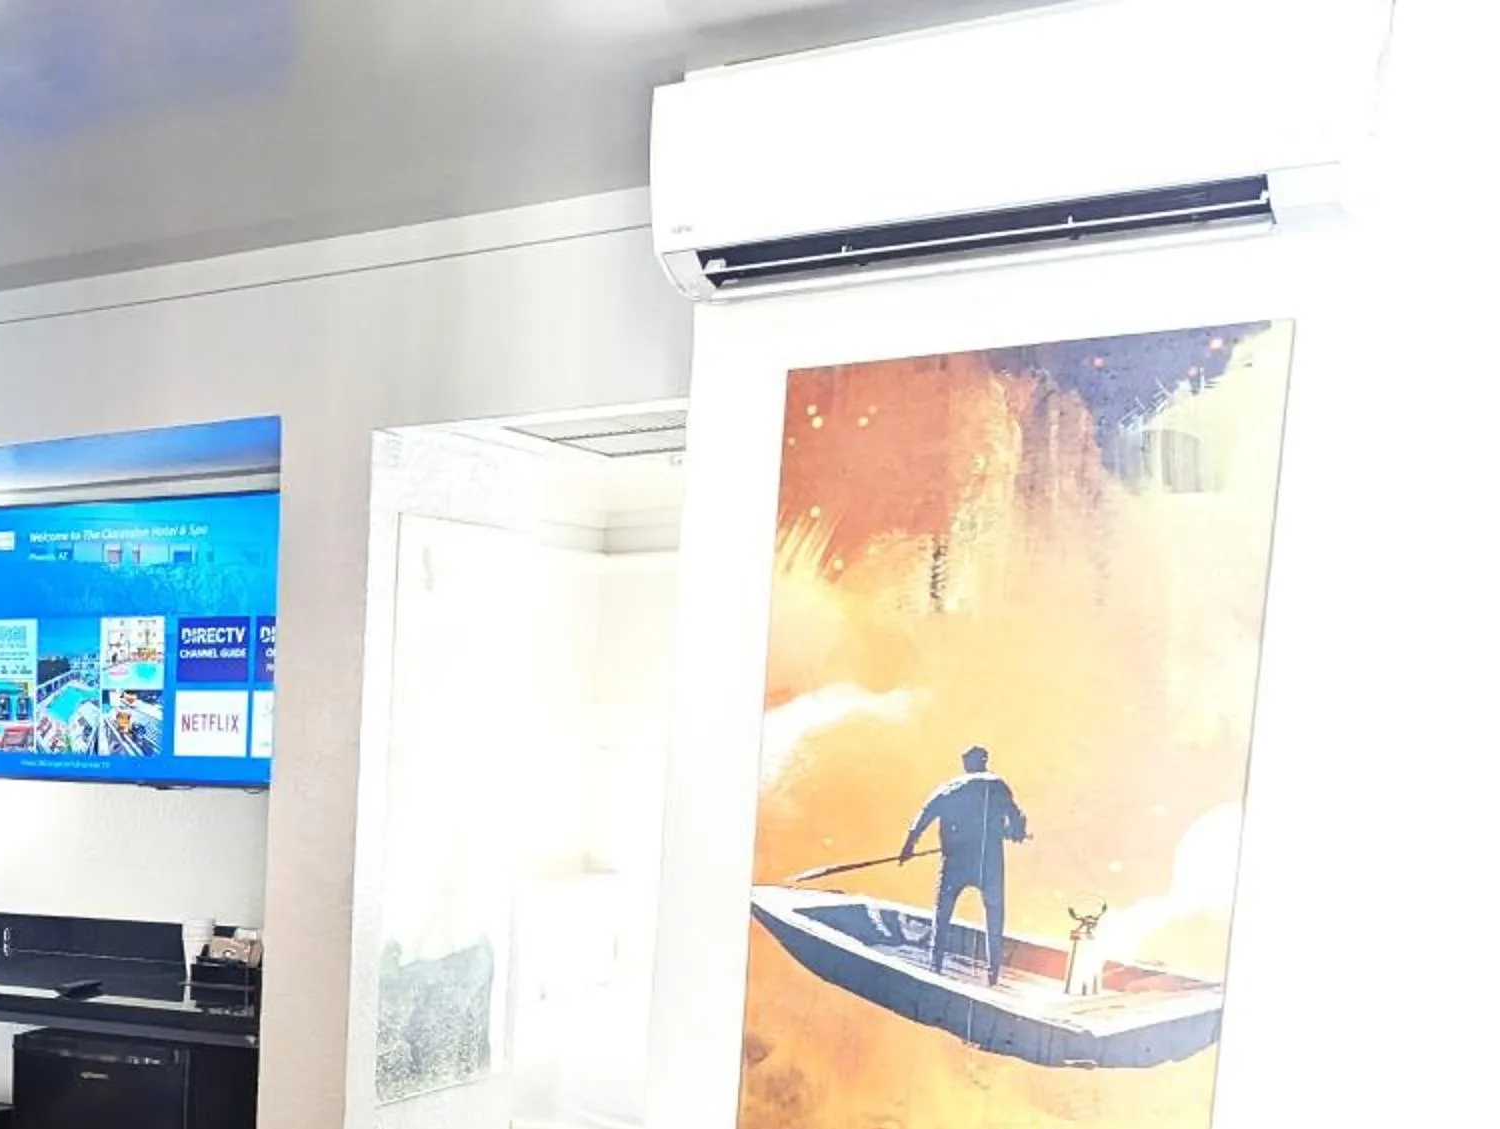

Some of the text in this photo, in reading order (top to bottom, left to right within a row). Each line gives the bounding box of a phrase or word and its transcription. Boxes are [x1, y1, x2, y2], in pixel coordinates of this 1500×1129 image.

[29, 531, 68, 543] Welcome
[71, 530, 81, 541] to
[83, 529, 100, 540] The
[181, 627, 244, 644] DIRECTV
[180, 647, 246, 659] CHANNEL GUIDE
[181, 713, 240, 735] NETFLIX
